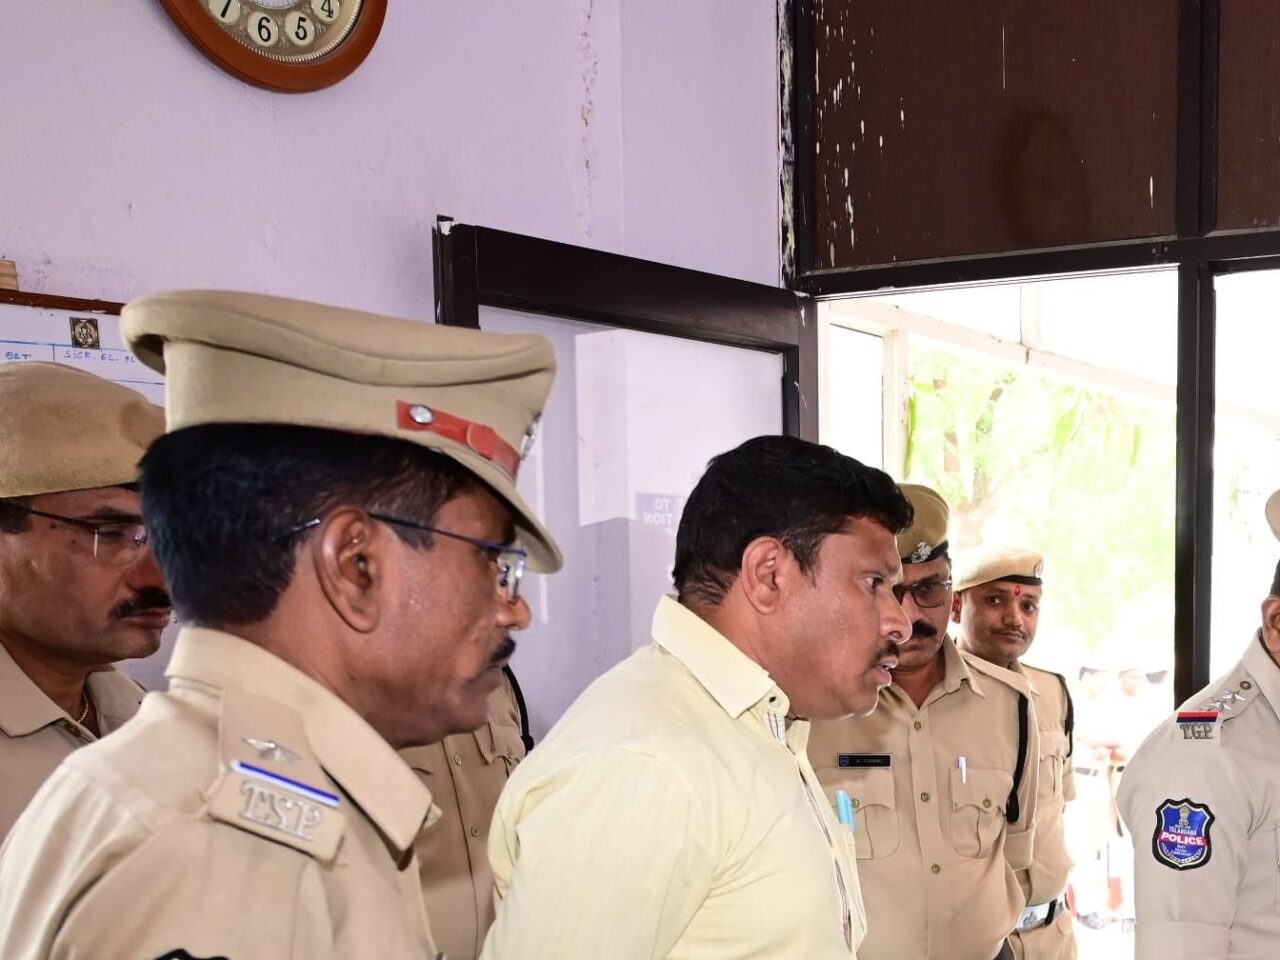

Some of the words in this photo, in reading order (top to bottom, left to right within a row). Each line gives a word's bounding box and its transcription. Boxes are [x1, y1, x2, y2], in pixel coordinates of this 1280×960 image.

[321, 0, 334, 18] 4
[257, 16, 271, 42] 6
[295, 16, 308, 41] 5
[1160, 831, 1205, 846] POLICE
